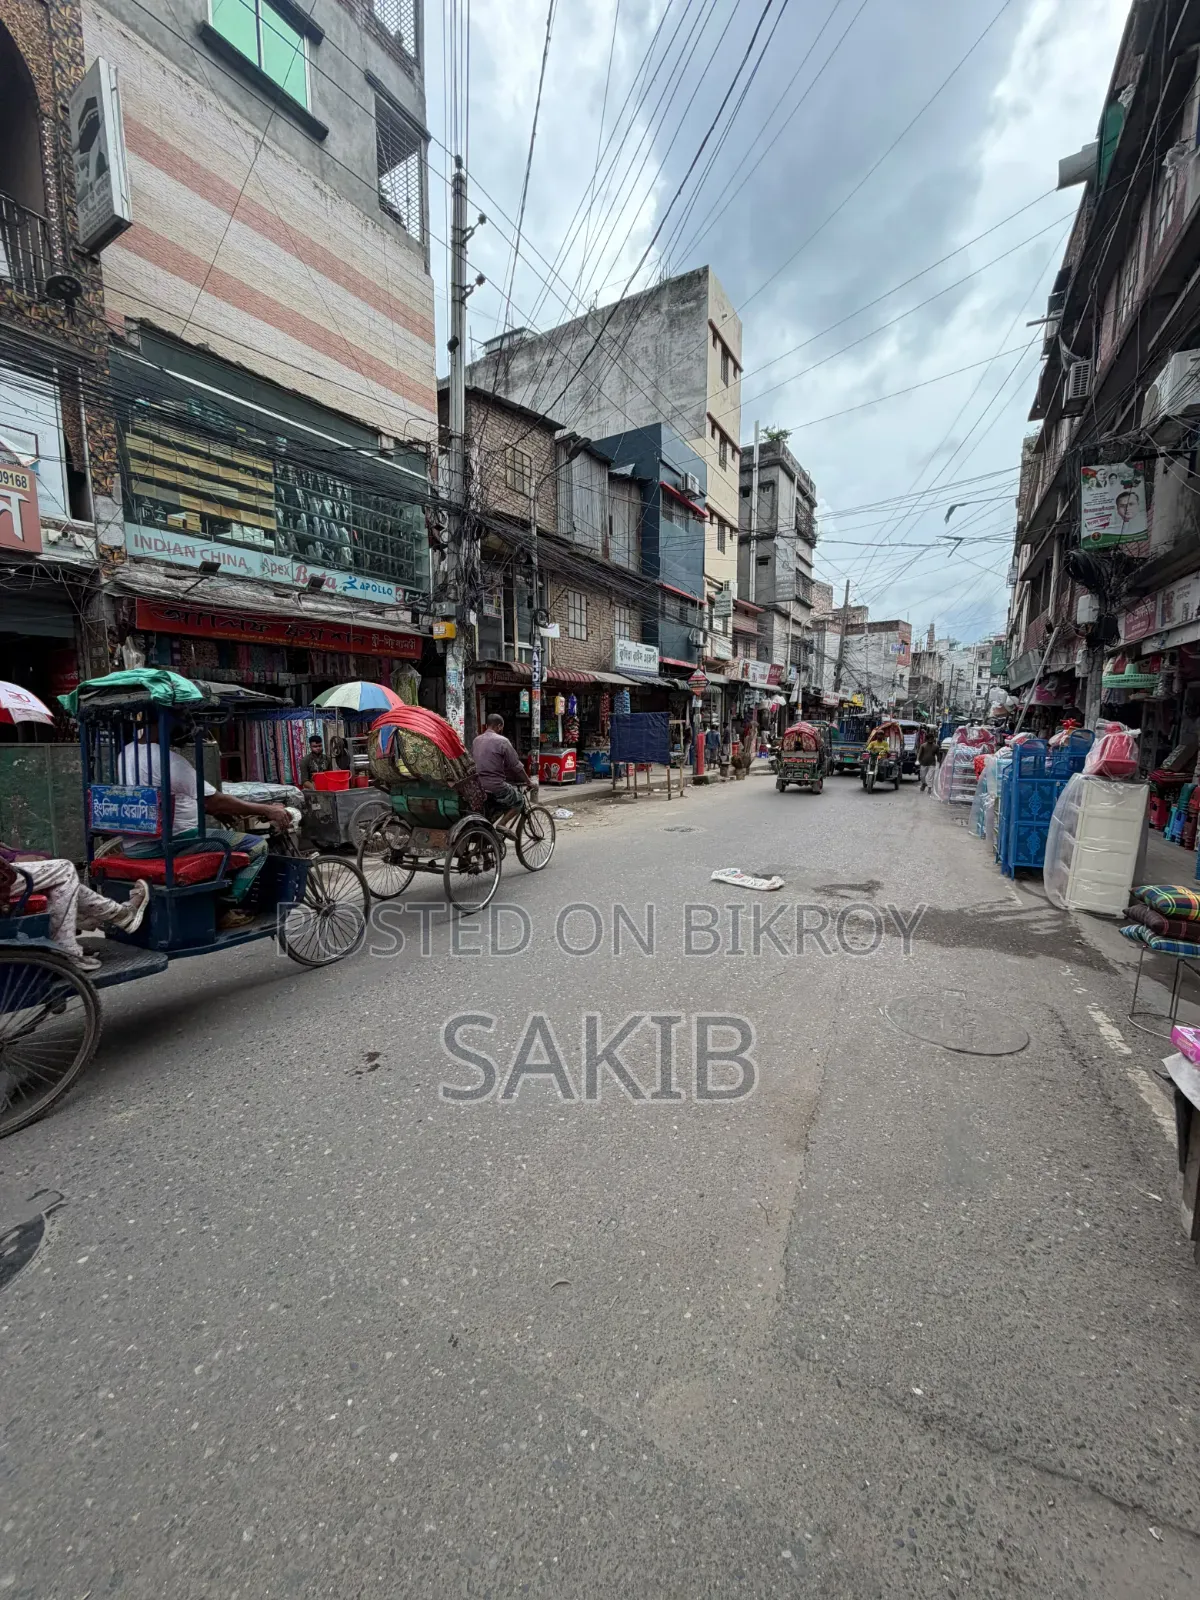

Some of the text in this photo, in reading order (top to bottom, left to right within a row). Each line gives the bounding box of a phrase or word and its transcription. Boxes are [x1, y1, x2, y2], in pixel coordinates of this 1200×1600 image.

[0, 470, 28, 489] 9168
[133, 533, 248, 569] INDIAN CHINA
[261, 557, 289, 577] Apex
[359, 581, 393, 596] APOLLO
[93, 797, 119, 818] ইংলিশ
[121, 799, 148, 819] থেরাপি
